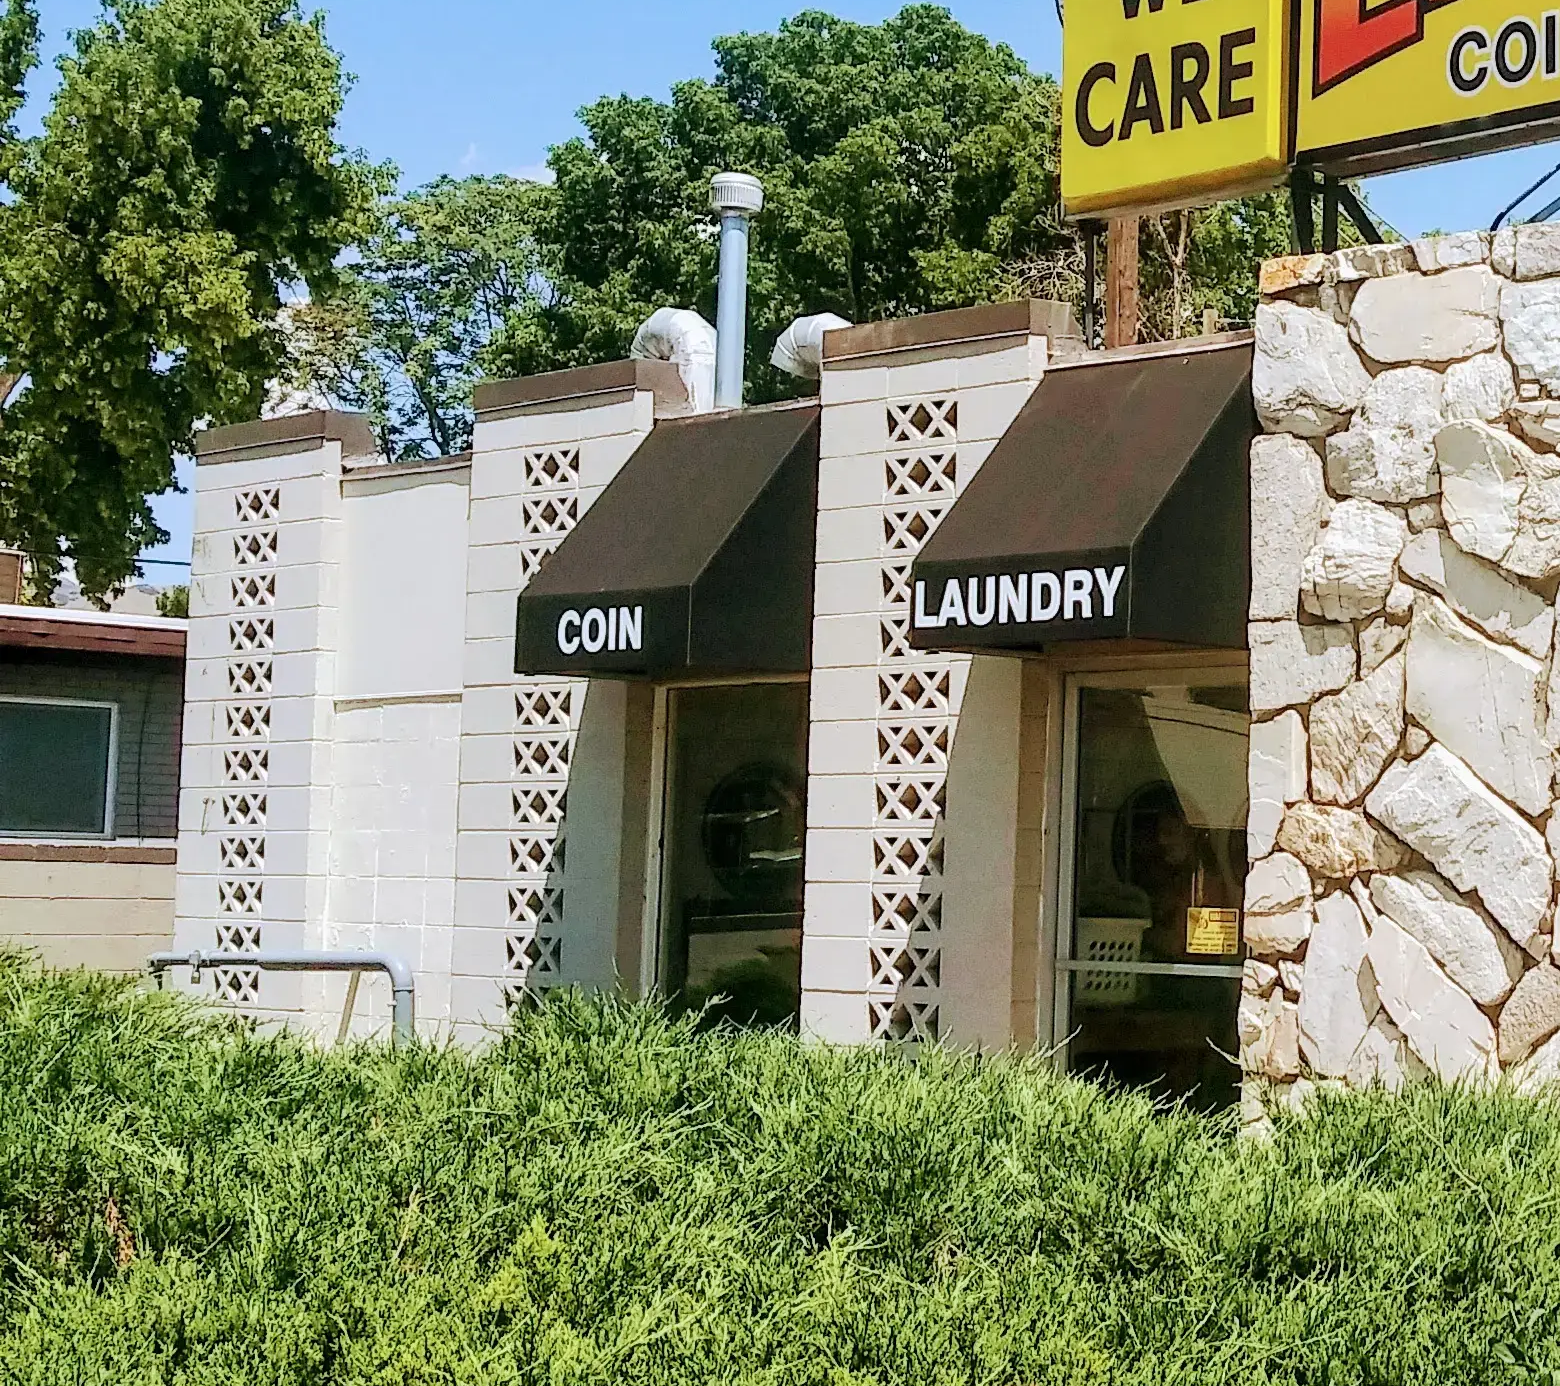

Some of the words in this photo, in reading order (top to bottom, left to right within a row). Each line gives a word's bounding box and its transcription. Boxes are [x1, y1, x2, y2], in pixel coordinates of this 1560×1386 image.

[1075, 28, 1256, 147] CARE
[914, 565, 1126, 629] LAUNDRY
[557, 605, 643, 655] COIN
